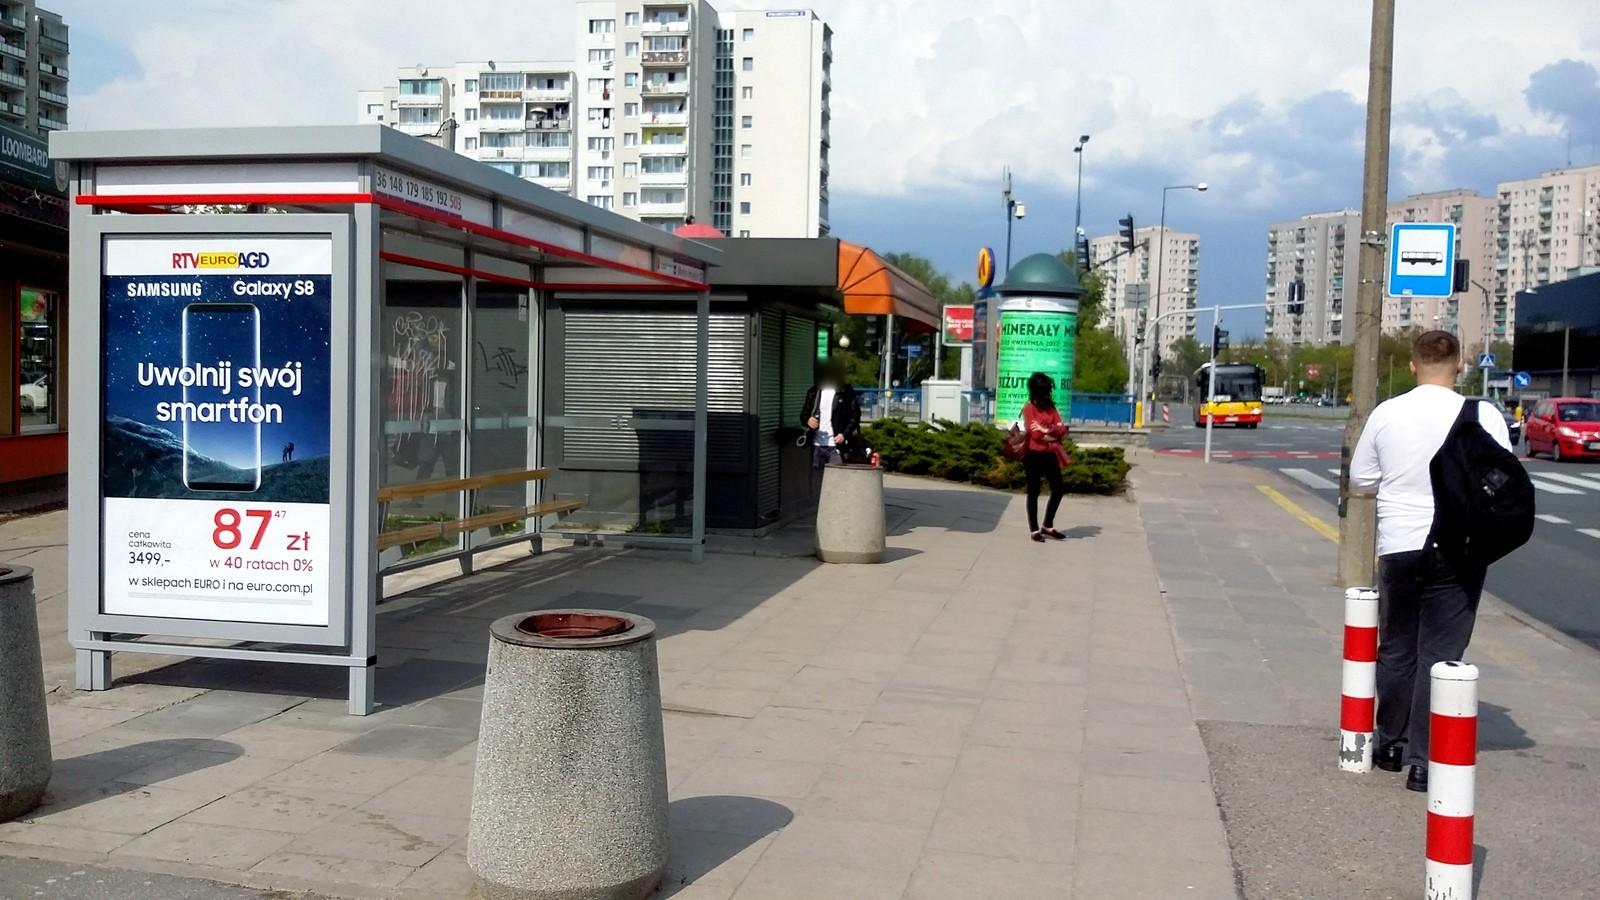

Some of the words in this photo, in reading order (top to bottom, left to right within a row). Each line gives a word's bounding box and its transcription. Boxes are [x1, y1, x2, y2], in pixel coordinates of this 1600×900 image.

[1, 135, 49, 168] LOOMBARD
[376, 171, 387, 188] 36
[389, 176, 403, 193] 148
[406, 181, 419, 198] 179
[421, 186, 434, 203] 185
[436, 190, 448, 206] 192
[127, 282, 202, 297] SAMSUNG
[233, 281, 292, 299] Galaxy
[294, 280, 315, 296] S8
[137, 361, 231, 395] Uwolnij
[238, 361, 302, 395] swój
[156, 397, 282, 423] smartfon
[128, 530, 150, 539] cena
[212, 508, 272, 550] 87
[274, 510, 287, 518] 47
[286, 531, 311, 551] zł
[128, 539, 171, 549] całkowita
[128, 551, 171, 567] 3499,-
[209, 558, 220, 568] w
[224, 556, 242, 569] 40
[246, 558, 289, 571] ratach
[293, 559, 313, 572] 0%
[128, 577, 139, 586] w
[141, 576, 192, 591] sklepach
[194, 578, 220, 589] EURO
[222, 579, 226, 590] i
[228, 581, 244, 591] na
[246, 581, 313, 595] euro.com.pl
